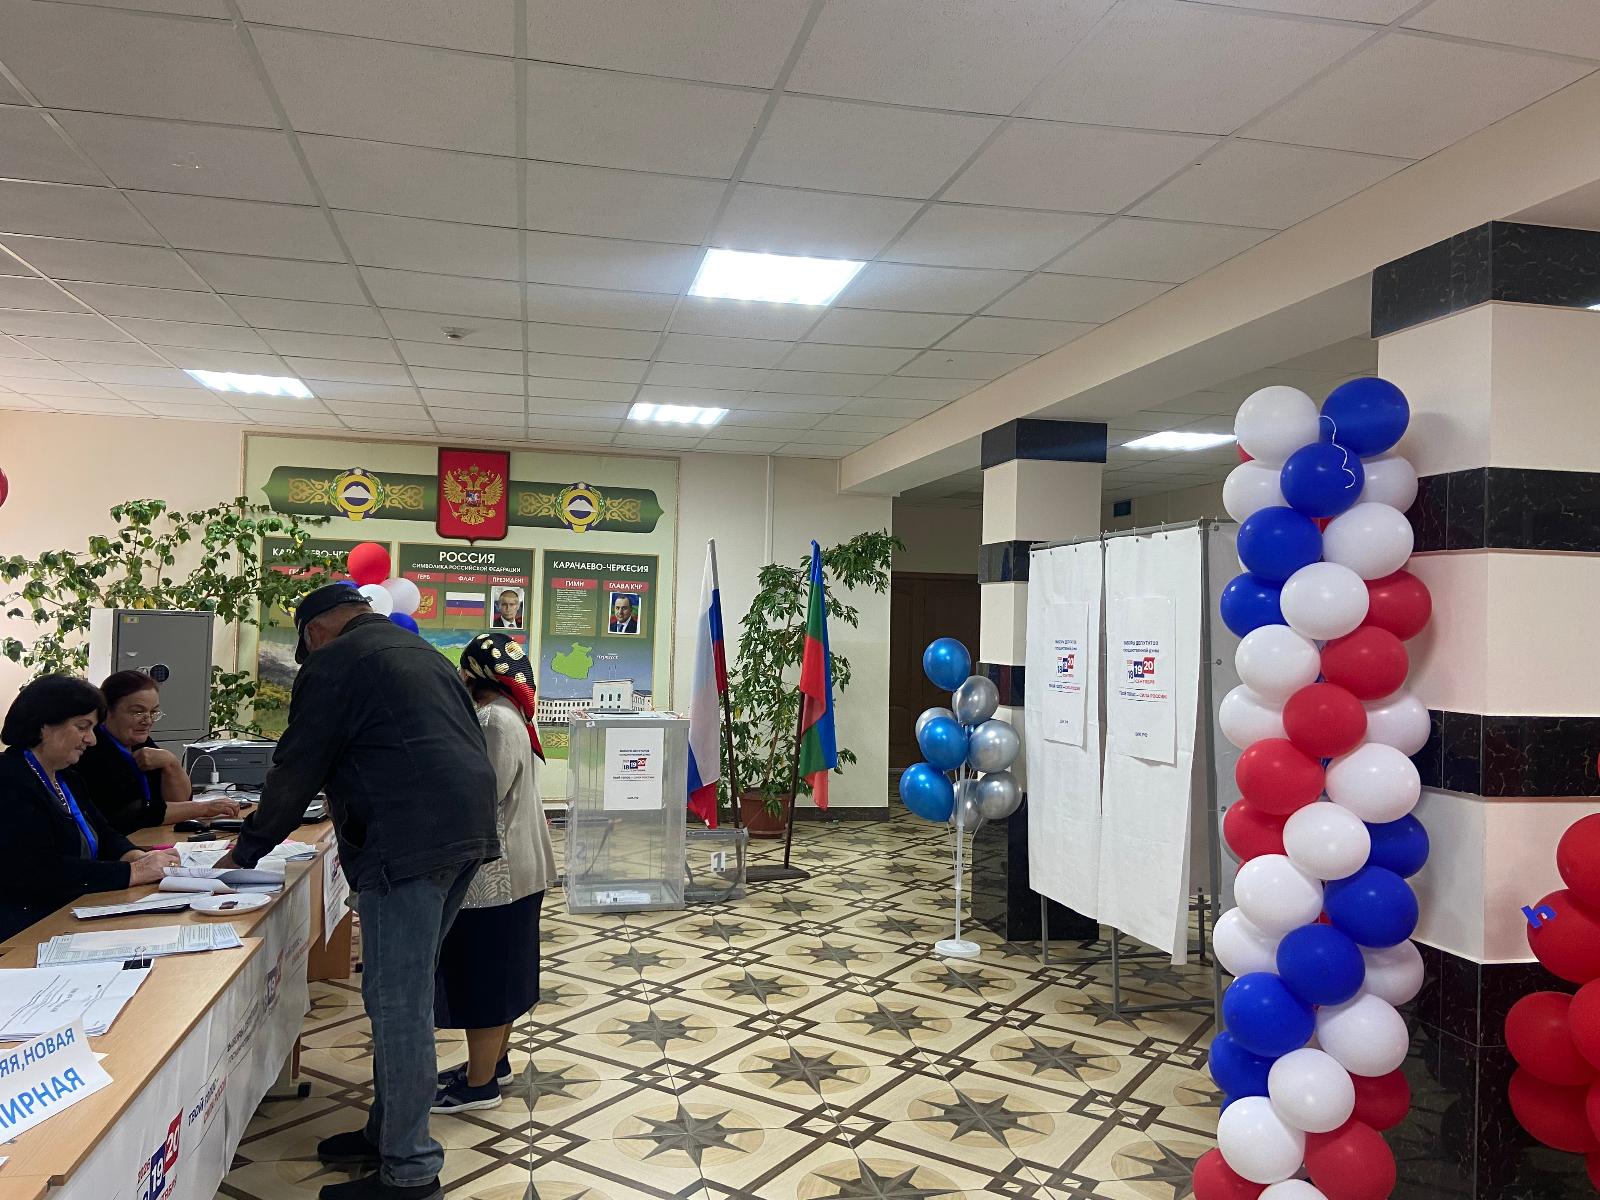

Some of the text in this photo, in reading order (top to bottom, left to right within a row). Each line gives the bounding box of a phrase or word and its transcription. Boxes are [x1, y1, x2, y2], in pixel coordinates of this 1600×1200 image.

[439, 551, 495, 564] РОССИЯ
[448, 564, 488, 572] РОССИЙСКОЙ
[553, 561, 649, 573] КАРАЧАЕВО-ЧЕРКЕСИЯ
[492, 576, 524, 584] ПРЕЗИДЕНТ
[609, 582, 629, 590] ГЛАВА
[1134, 665, 1143, 675] 19
[1144, 660, 1154, 671] 20
[713, 852, 725, 872] 1
[0, 1066, 86, 1129] ИРНАЯ
[165, 1124, 180, 1162] 20
[151, 1157, 164, 1193] 19
